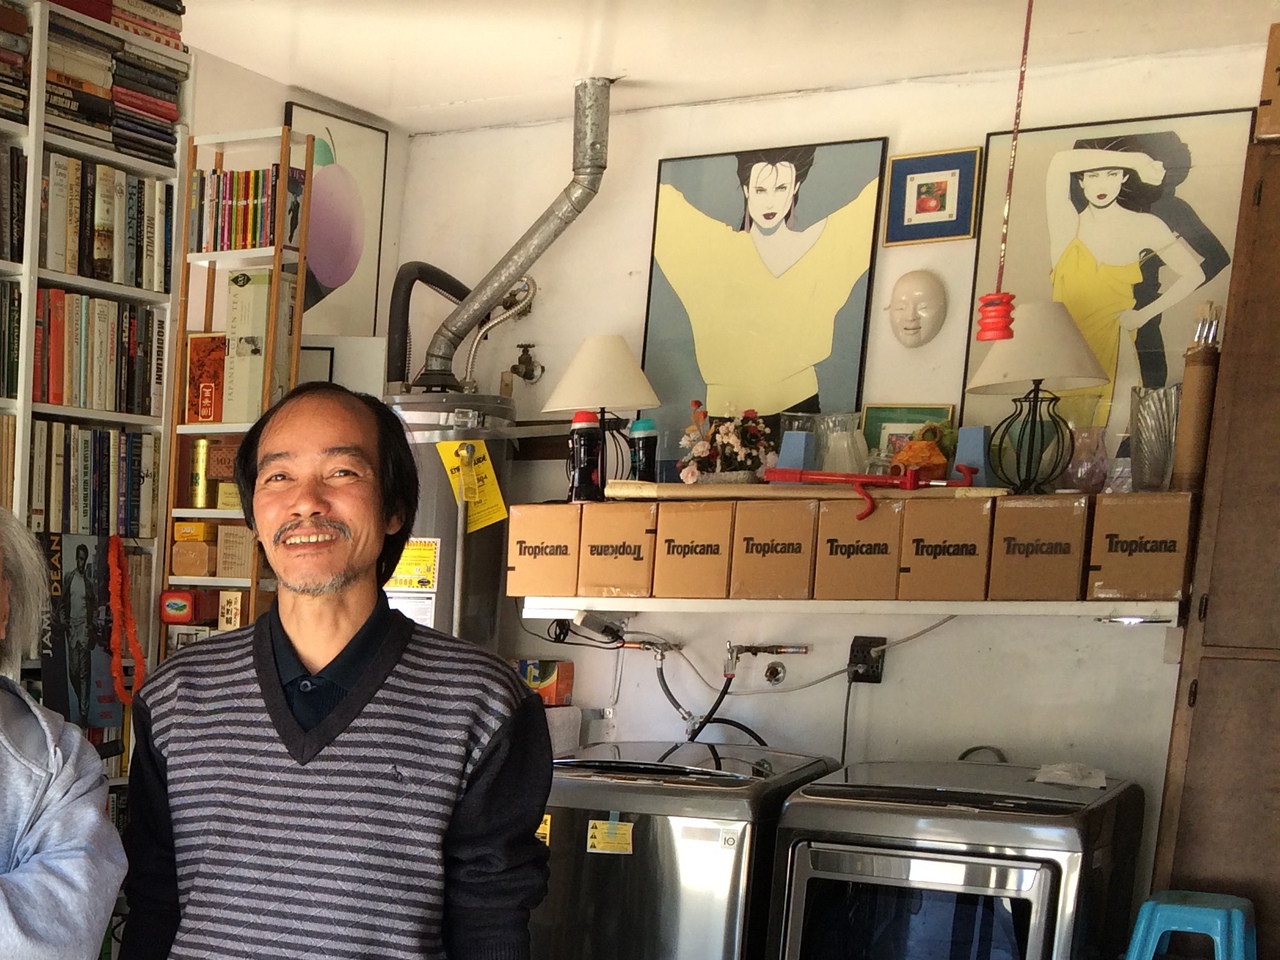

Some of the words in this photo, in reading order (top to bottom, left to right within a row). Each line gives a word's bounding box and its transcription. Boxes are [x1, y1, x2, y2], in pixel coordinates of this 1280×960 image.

[126, 184, 136, 249] Beckett
[145, 216, 156, 261] MELVILLE
[231, 292, 239, 307] TEA
[108, 321, 116, 364] ORWELL
[229, 312, 237, 353] GREEN
[154, 318, 165, 386] MODIGLIANI
[227, 356, 236, 402] JAPANESE
[516, 540, 569, 559] Tropicana
[589, 541, 643, 561] Tropicana
[665, 538, 721, 559] Tropicana
[743, 537, 802, 558] Tropicana
[827, 538, 889, 559] Tropicana
[913, 538, 977, 559] Tropicana
[1004, 536, 1072, 558] Tropicana
[1105, 533, 1177, 556] Tropicana
[50, 534, 62, 597] DEAN
[41, 612, 53, 658] JAME
